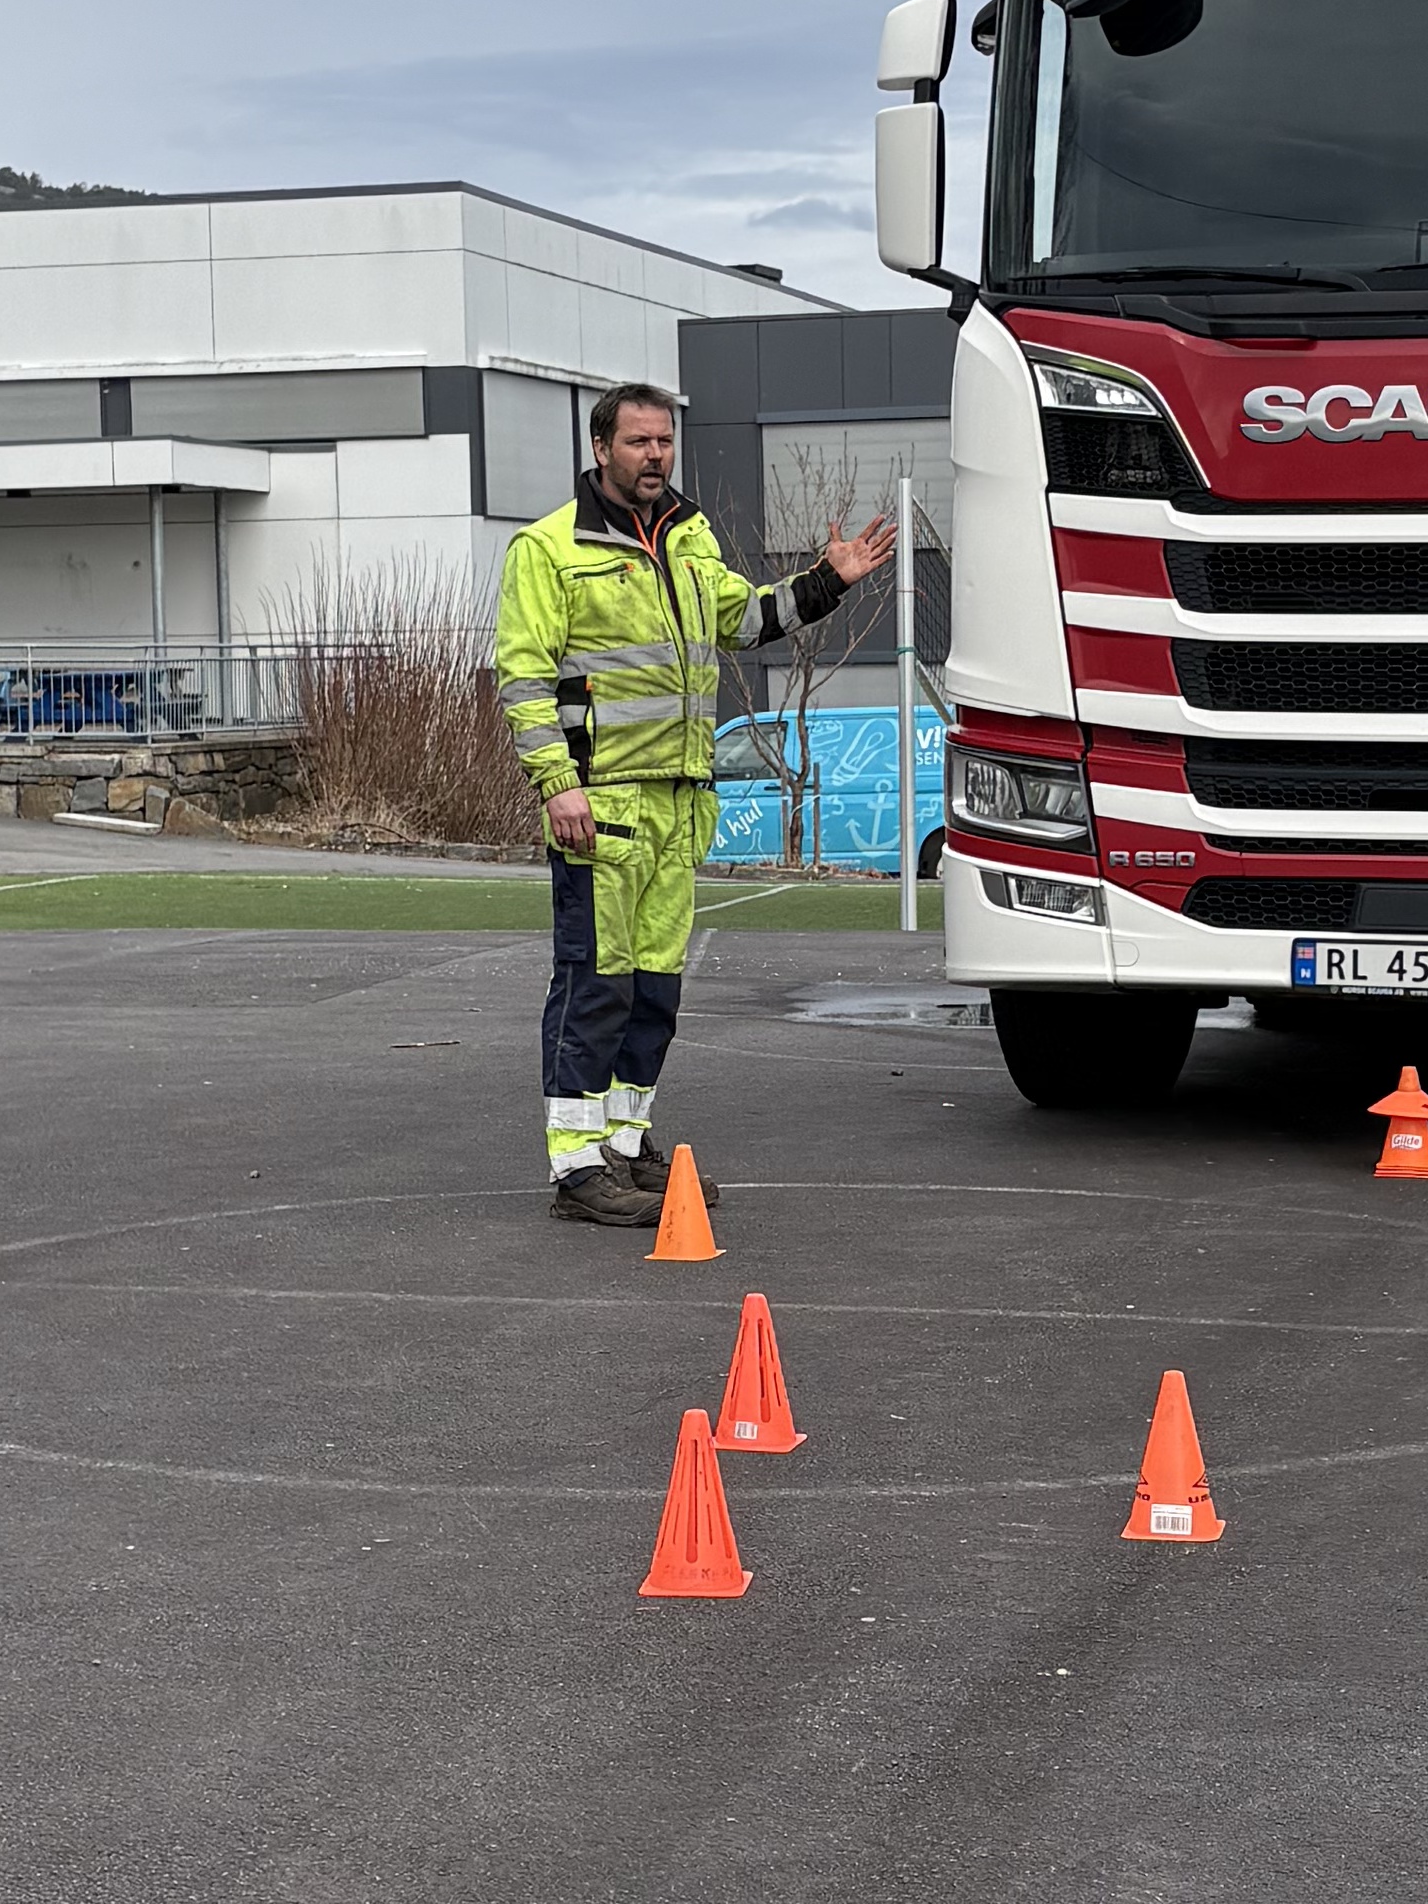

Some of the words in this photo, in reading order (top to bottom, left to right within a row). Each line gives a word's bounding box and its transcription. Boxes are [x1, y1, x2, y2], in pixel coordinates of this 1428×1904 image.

[725, 798, 763, 837] hjul
[1109, 850, 1130, 867] R
[1134, 850, 1196, 867] 650
[1326, 948, 1368, 981] RL
